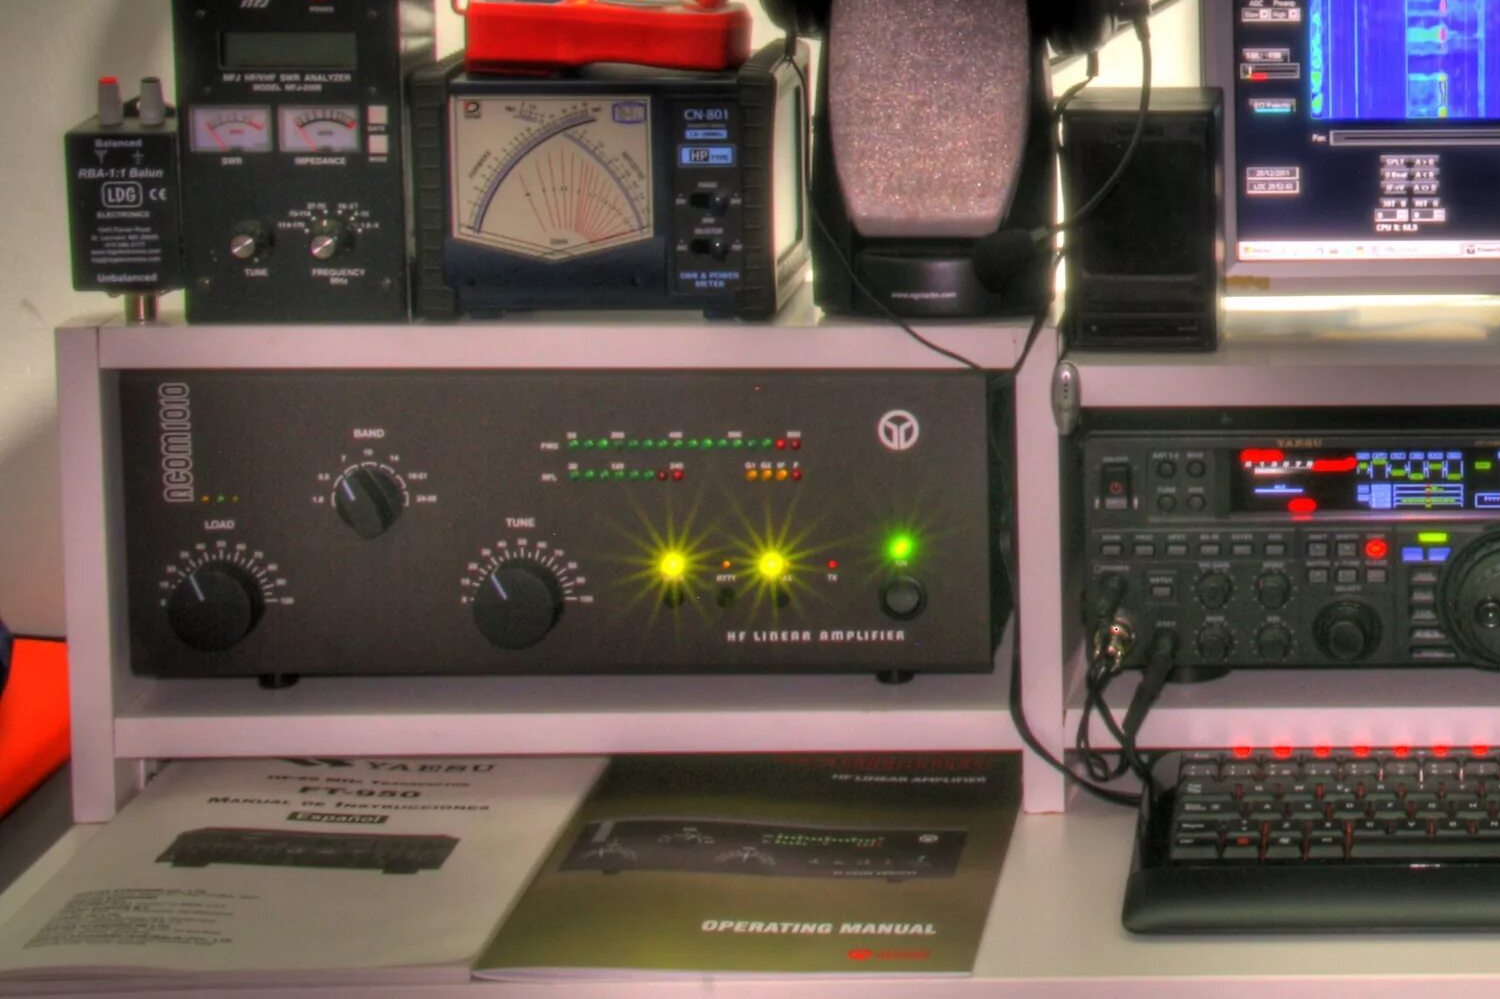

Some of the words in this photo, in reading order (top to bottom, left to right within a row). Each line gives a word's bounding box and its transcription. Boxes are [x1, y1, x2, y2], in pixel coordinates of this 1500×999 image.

[279, 73, 300, 82] SWR
[304, 73, 351, 82] ANALYZER
[253, 84, 281, 92] MODEL
[684, 109, 728, 121] CN-801
[95, 139, 142, 148] Balanced
[221, 157, 242, 165] SWR
[294, 157, 346, 165] IMPEDANCE
[690, 150, 709, 163] HP
[78, 168, 126, 179] RBA-1:1
[129, 168, 164, 179] Balun
[107, 187, 136, 203] LDG
[96, 211, 150, 219] ELECTRONICS
[245, 268, 268, 276] TUNE
[312, 268, 365, 276] FREQUENCY
[97, 273, 157, 283] Unbalanced
[353, 429, 384, 438] BAND
[1277, 440, 1322, 448] YAESU
[204, 520, 236, 530] LOAD
[505, 518, 535, 527] TUNE
[727, 631, 746, 641] HF
[754, 631, 811, 641] LINEAR
[819, 631, 905, 641] AMPLIFIER
[367, 761, 497, 773] YAESU
[299, 786, 421, 799] FT-950
[293, 813, 382, 825] Español
[701, 919, 833, 934] OPERATING
[839, 922, 937, 936] MANUAL
